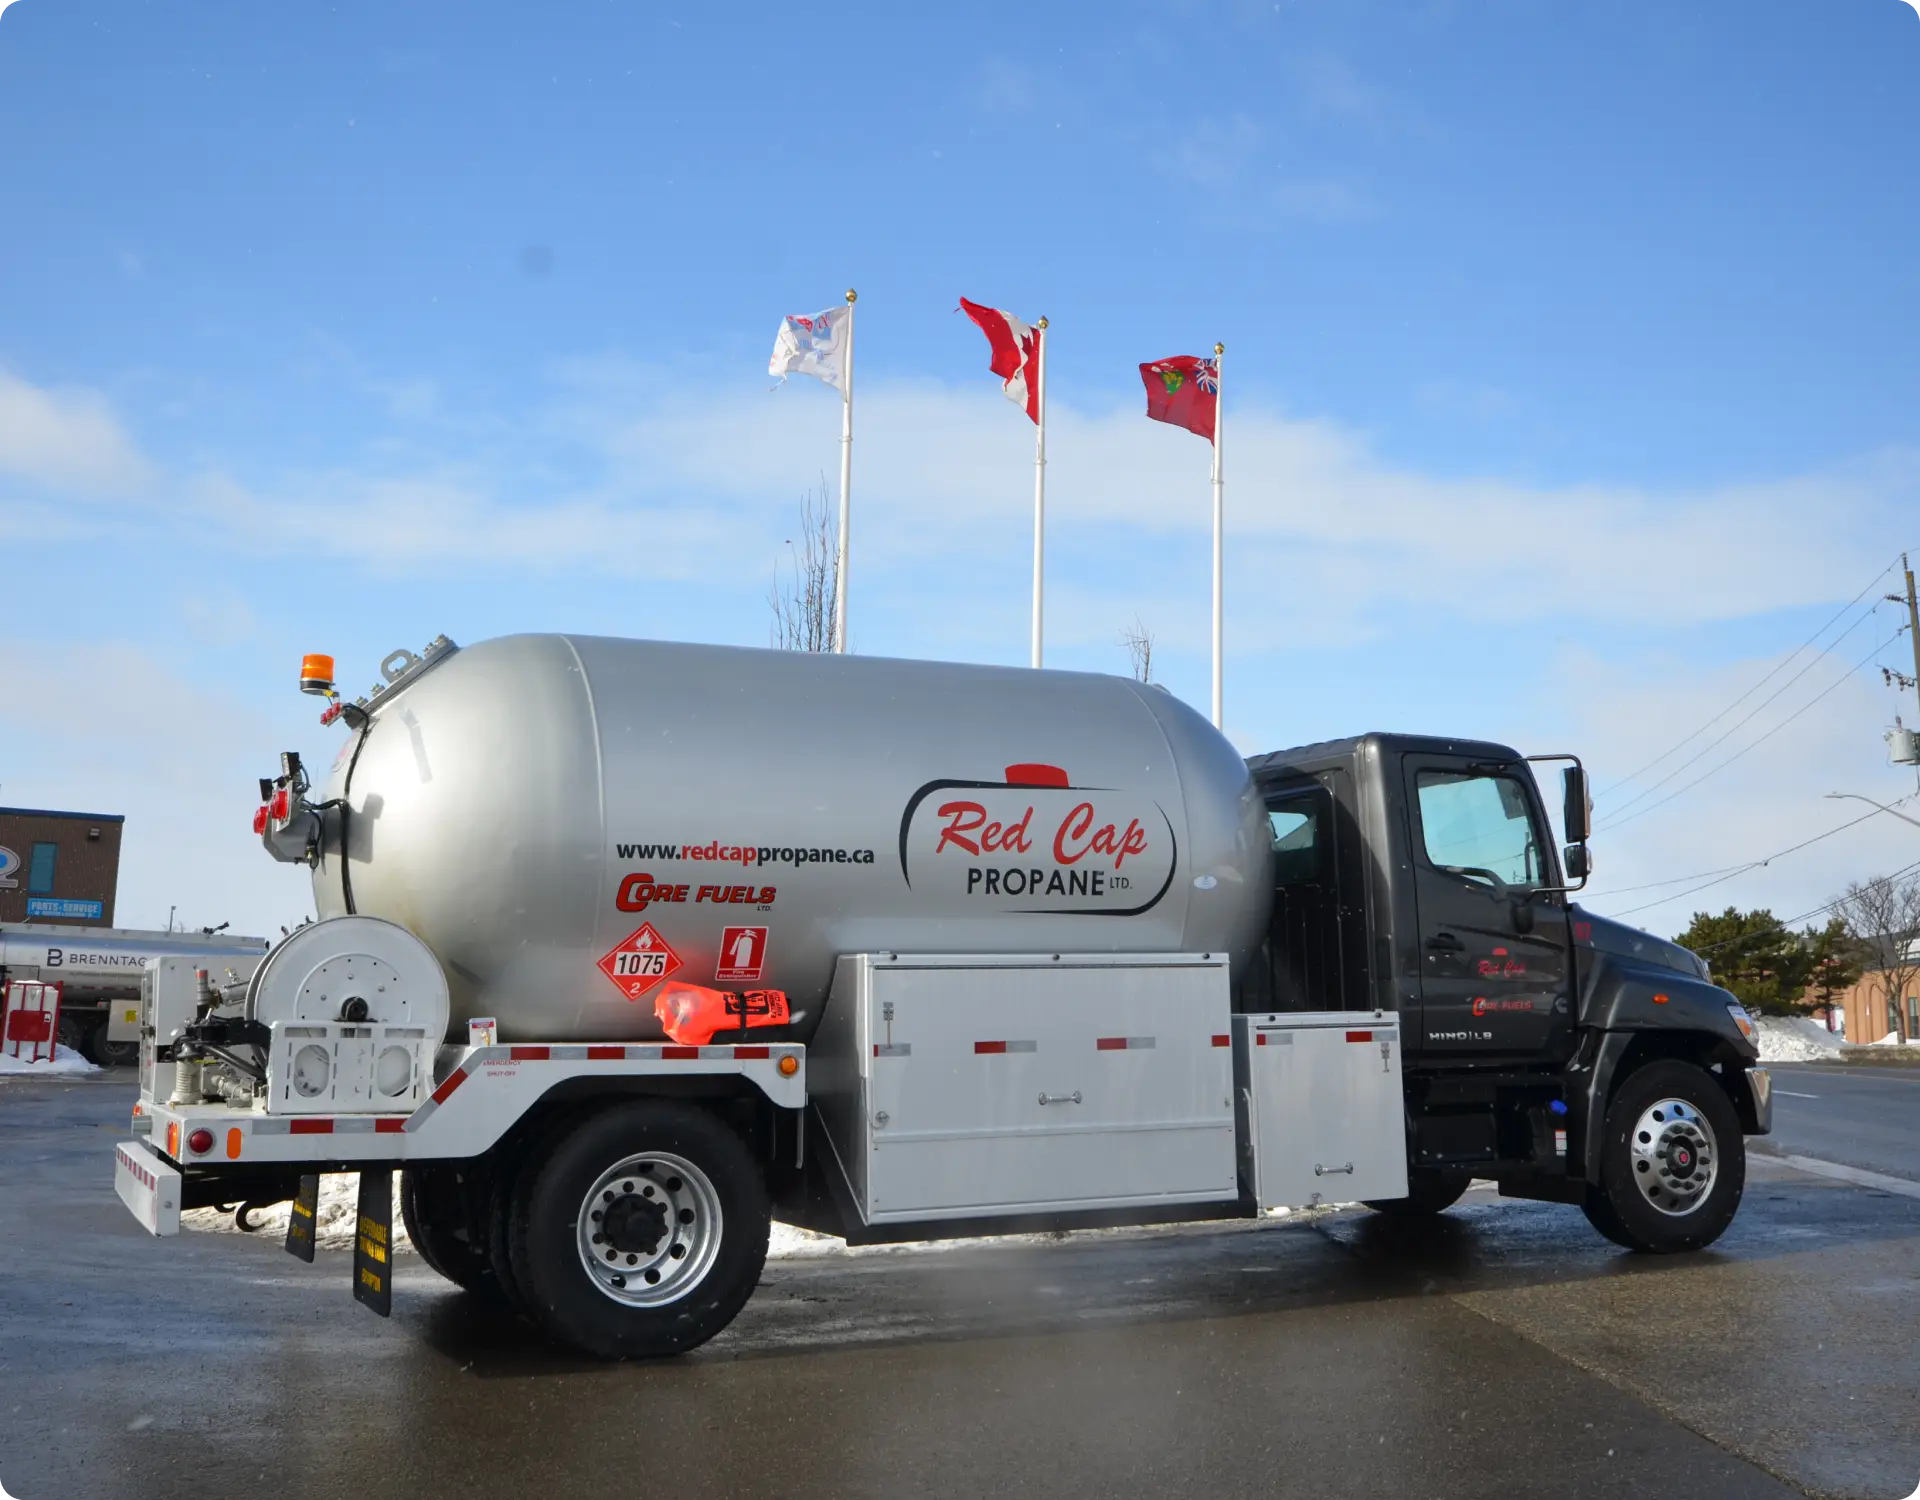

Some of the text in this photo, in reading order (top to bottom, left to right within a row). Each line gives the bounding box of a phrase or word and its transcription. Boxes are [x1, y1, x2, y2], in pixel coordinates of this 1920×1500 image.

[935, 801, 1148, 869] Red Cap
[616, 841, 874, 867] www.redcappropane.ca
[616, 873, 777, 913] CORE FUELS
[967, 868, 1133, 896] PROPANE LTD.
[69, 953, 147, 967] BRENNTAG
[618, 953, 665, 975] 1075
[630, 982, 641, 994] 2
